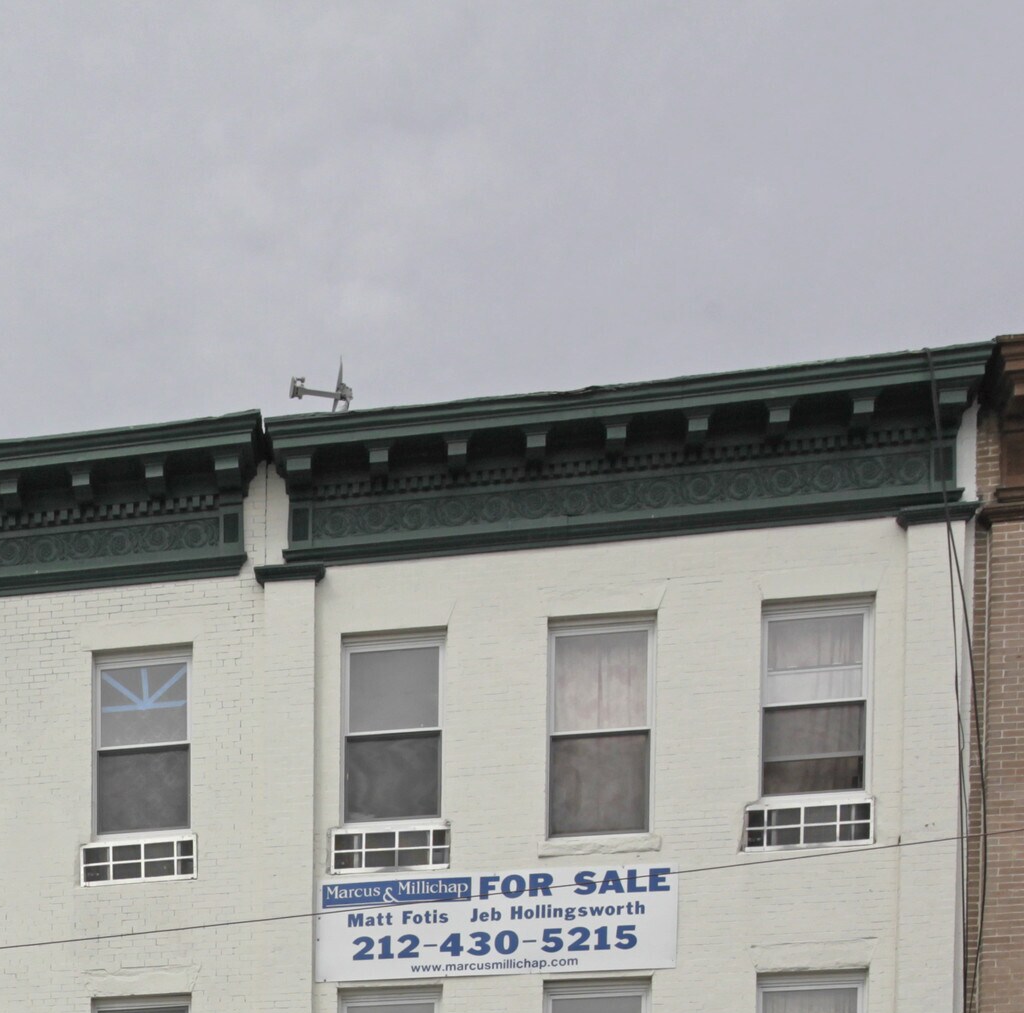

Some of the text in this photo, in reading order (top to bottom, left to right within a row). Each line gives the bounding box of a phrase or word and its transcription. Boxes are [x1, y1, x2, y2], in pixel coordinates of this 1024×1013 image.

[326, 880, 469, 903] Marcus & Millichap
[479, 867, 671, 900] FOR SALE
[347, 900, 646, 928] Matt Fotis Jeb Hollingsworth
[352, 925, 638, 961] 212-430-5215
[410, 956, 579, 973] www.marcusmillichap.com
